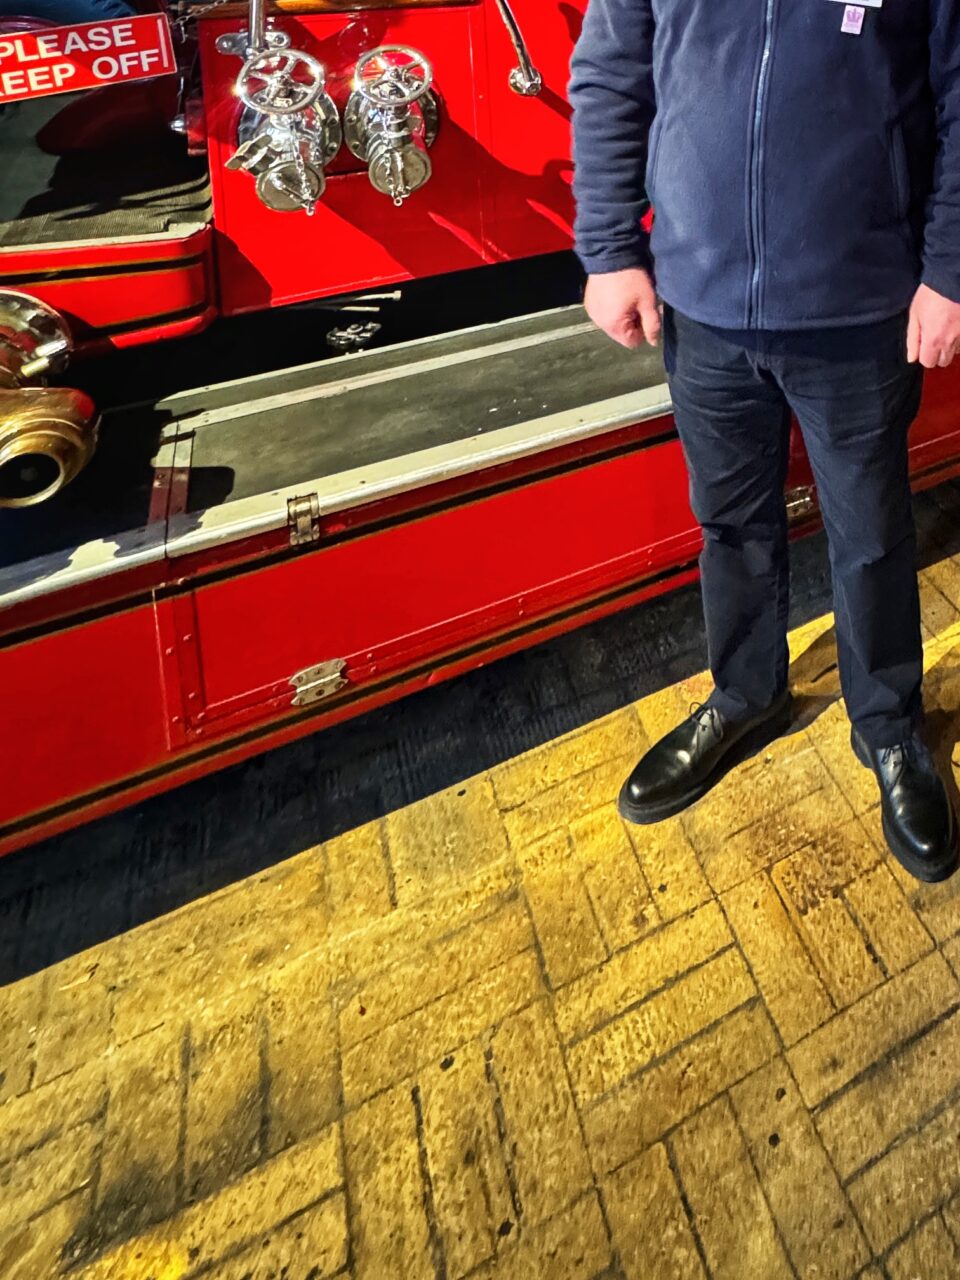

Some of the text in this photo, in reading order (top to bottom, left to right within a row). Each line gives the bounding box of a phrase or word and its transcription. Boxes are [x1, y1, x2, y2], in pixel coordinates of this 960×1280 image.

[0, 23, 137, 65] PLEASE
[0, 48, 160, 97] EEP OFF
